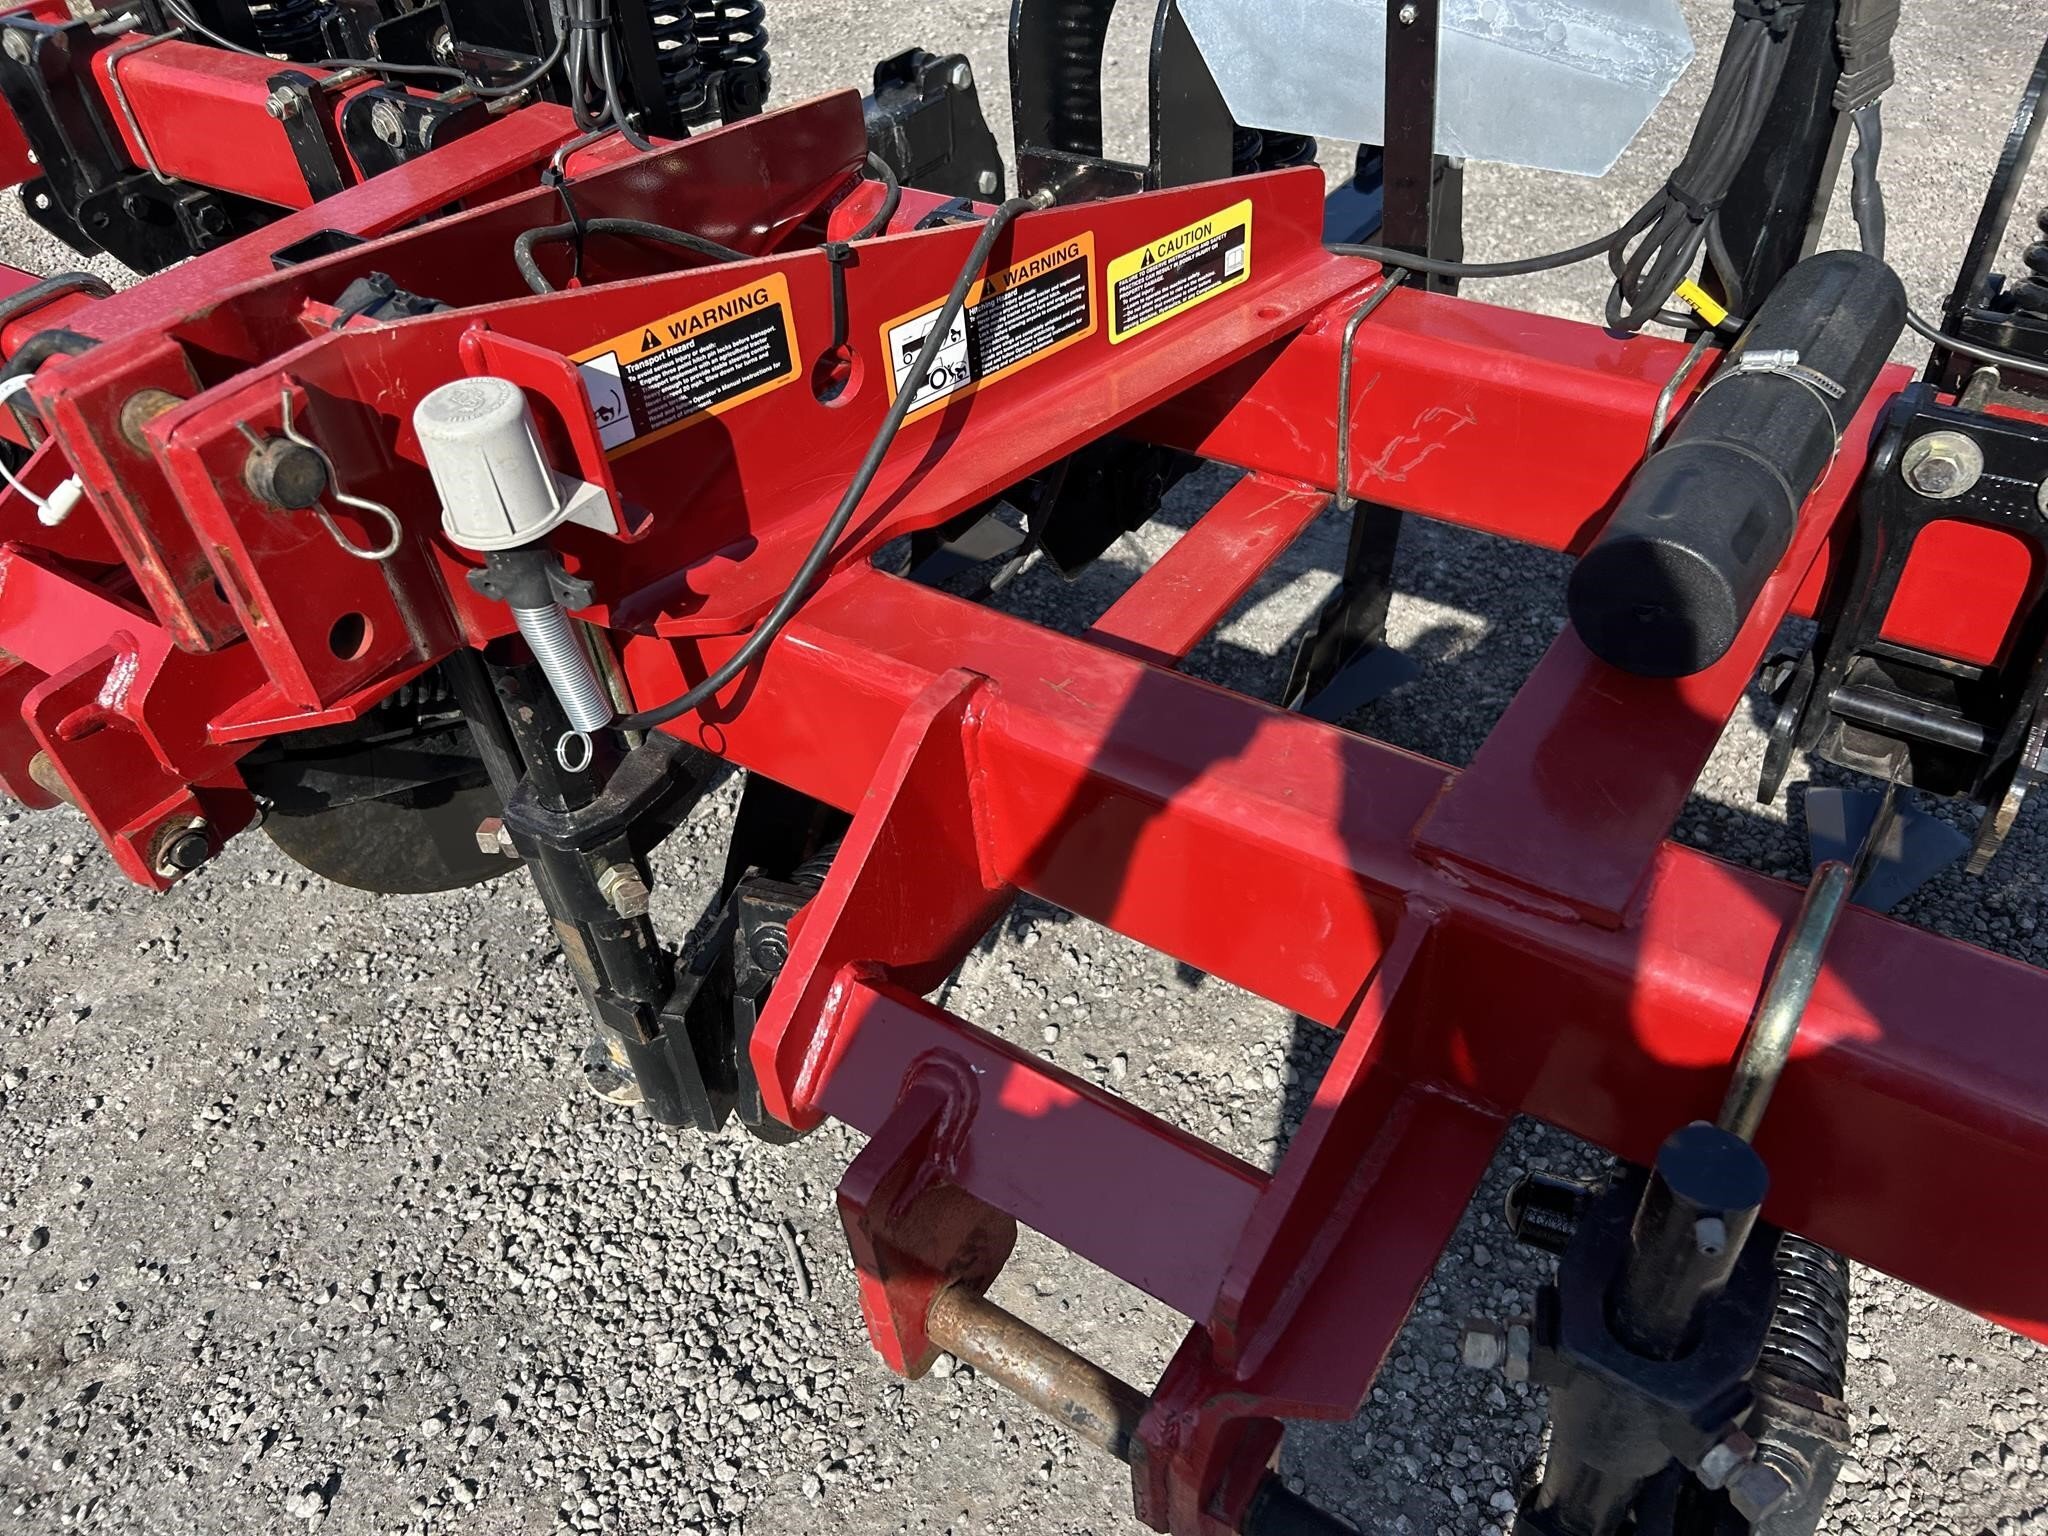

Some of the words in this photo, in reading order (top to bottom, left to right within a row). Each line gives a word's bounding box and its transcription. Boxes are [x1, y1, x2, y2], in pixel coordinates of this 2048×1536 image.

[1157, 222, 1211, 258] CAUTION
[1199, 240, 1209, 250] AND
[1210, 232, 1226, 245] SAFETY
[1003, 241, 1079, 288] WARNING
[1119, 276, 1144, 293] PRACTICES
[1144, 271, 1155, 281] CAN
[1155, 263, 1172, 276] RESULT
[968, 297, 995, 316] Hitching
[996, 287, 1017, 303] Hazard
[1119, 283, 1143, 300] PROPERTY
[1681, 294, 1702, 312] LEFT
[667, 286, 769, 341] WARNING
[625, 351, 666, 374] Transport
[666, 339, 695, 357] Hazard
[636, 367, 652, 378] avoid
[653, 358, 674, 372] serious
[639, 372, 661, 386] Engage
[661, 365, 676, 376] three
[677, 359, 692, 371] point
[692, 353, 706, 364] hitch
[716, 343, 731, 354] locks
[732, 335, 749, 347] before
[750, 324, 776, 341] transport.
[669, 365, 698, 383] implement
[698, 360, 710, 370] with
[718, 343, 749, 362] agricultural
[749, 336, 767, 348] tractor
[704, 372, 718, 382] Slow
[719, 365, 734, 376] down
[758, 350, 769, 359] and
[660, 379, 682, 394] enough
[689, 367, 710, 382] provide
[711, 360, 727, 372] stable
[728, 351, 750, 366] steering
[692, 386, 721, 404] Operator's
[721, 377, 741, 391] Manual
